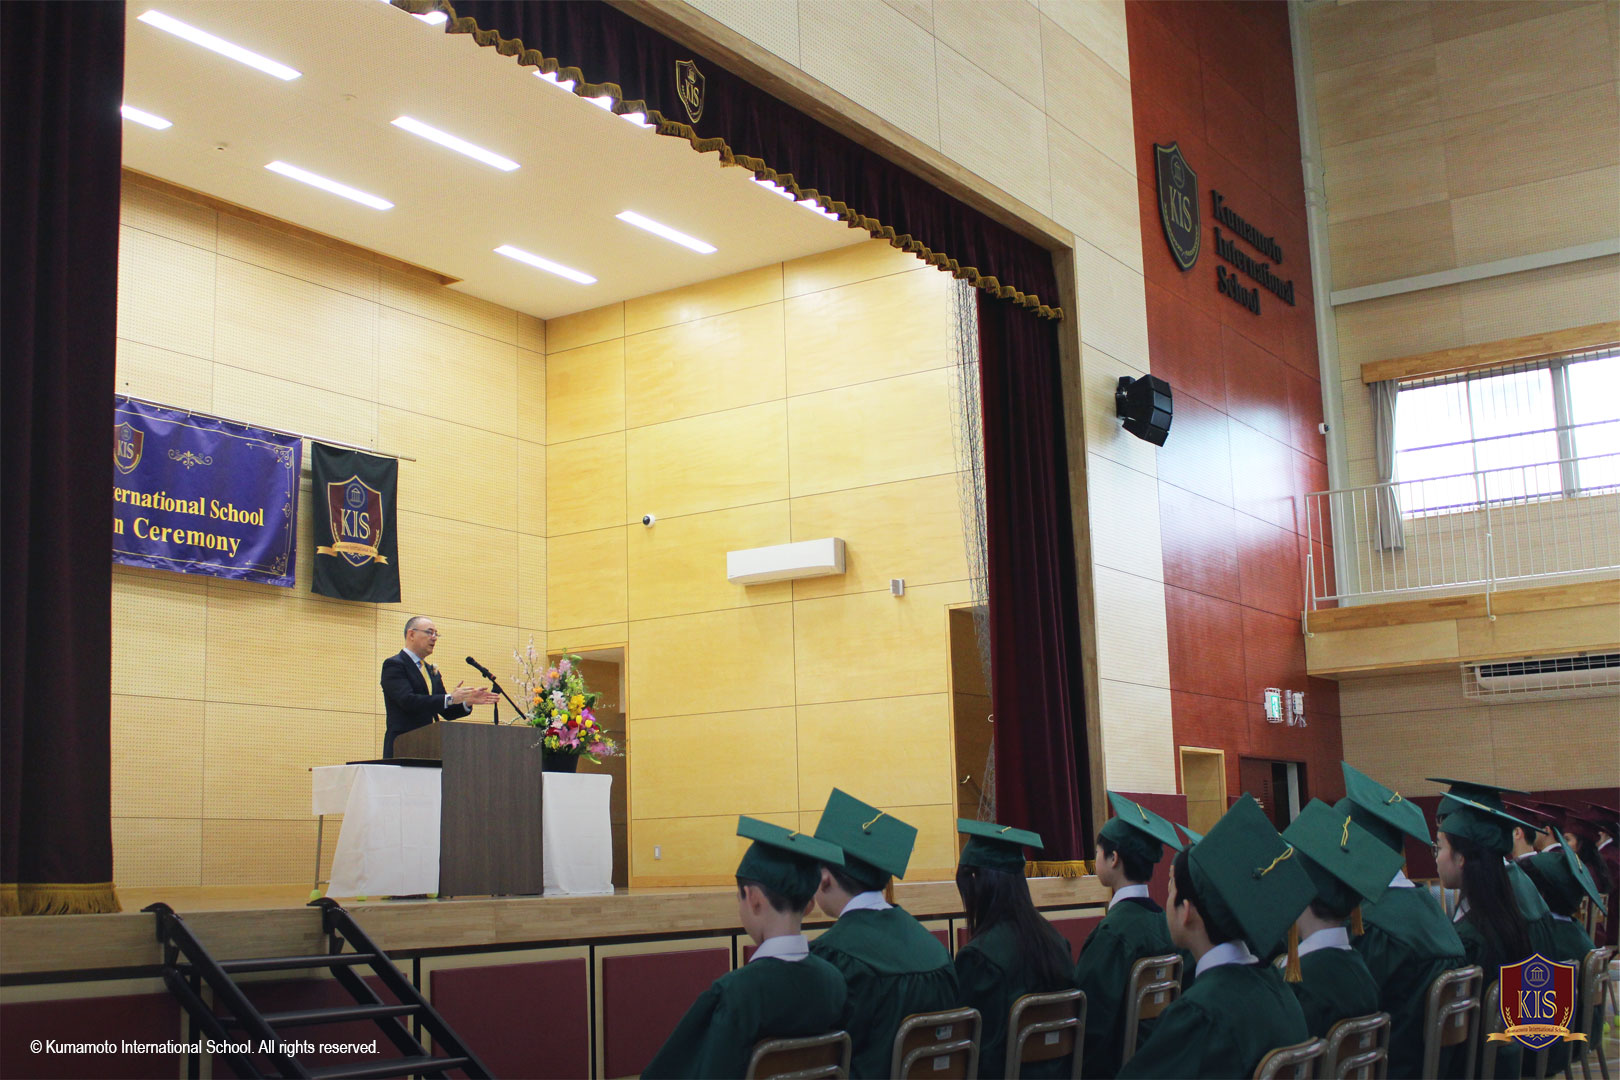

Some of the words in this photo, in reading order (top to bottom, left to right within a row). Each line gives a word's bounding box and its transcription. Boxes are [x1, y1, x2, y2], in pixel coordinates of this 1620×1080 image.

[685, 79, 700, 107] KIS
[1169, 185, 1192, 233] KIS
[1211, 189, 1283, 265] Kumamoto
[1214, 226, 1296, 307] International
[1217, 265, 1261, 316] School
[117, 439, 135, 460] KIS
[113, 487, 206, 516] ernational
[210, 499, 264, 527] School
[340, 508, 371, 539] KIS
[133, 517, 241, 558] Ceremony
